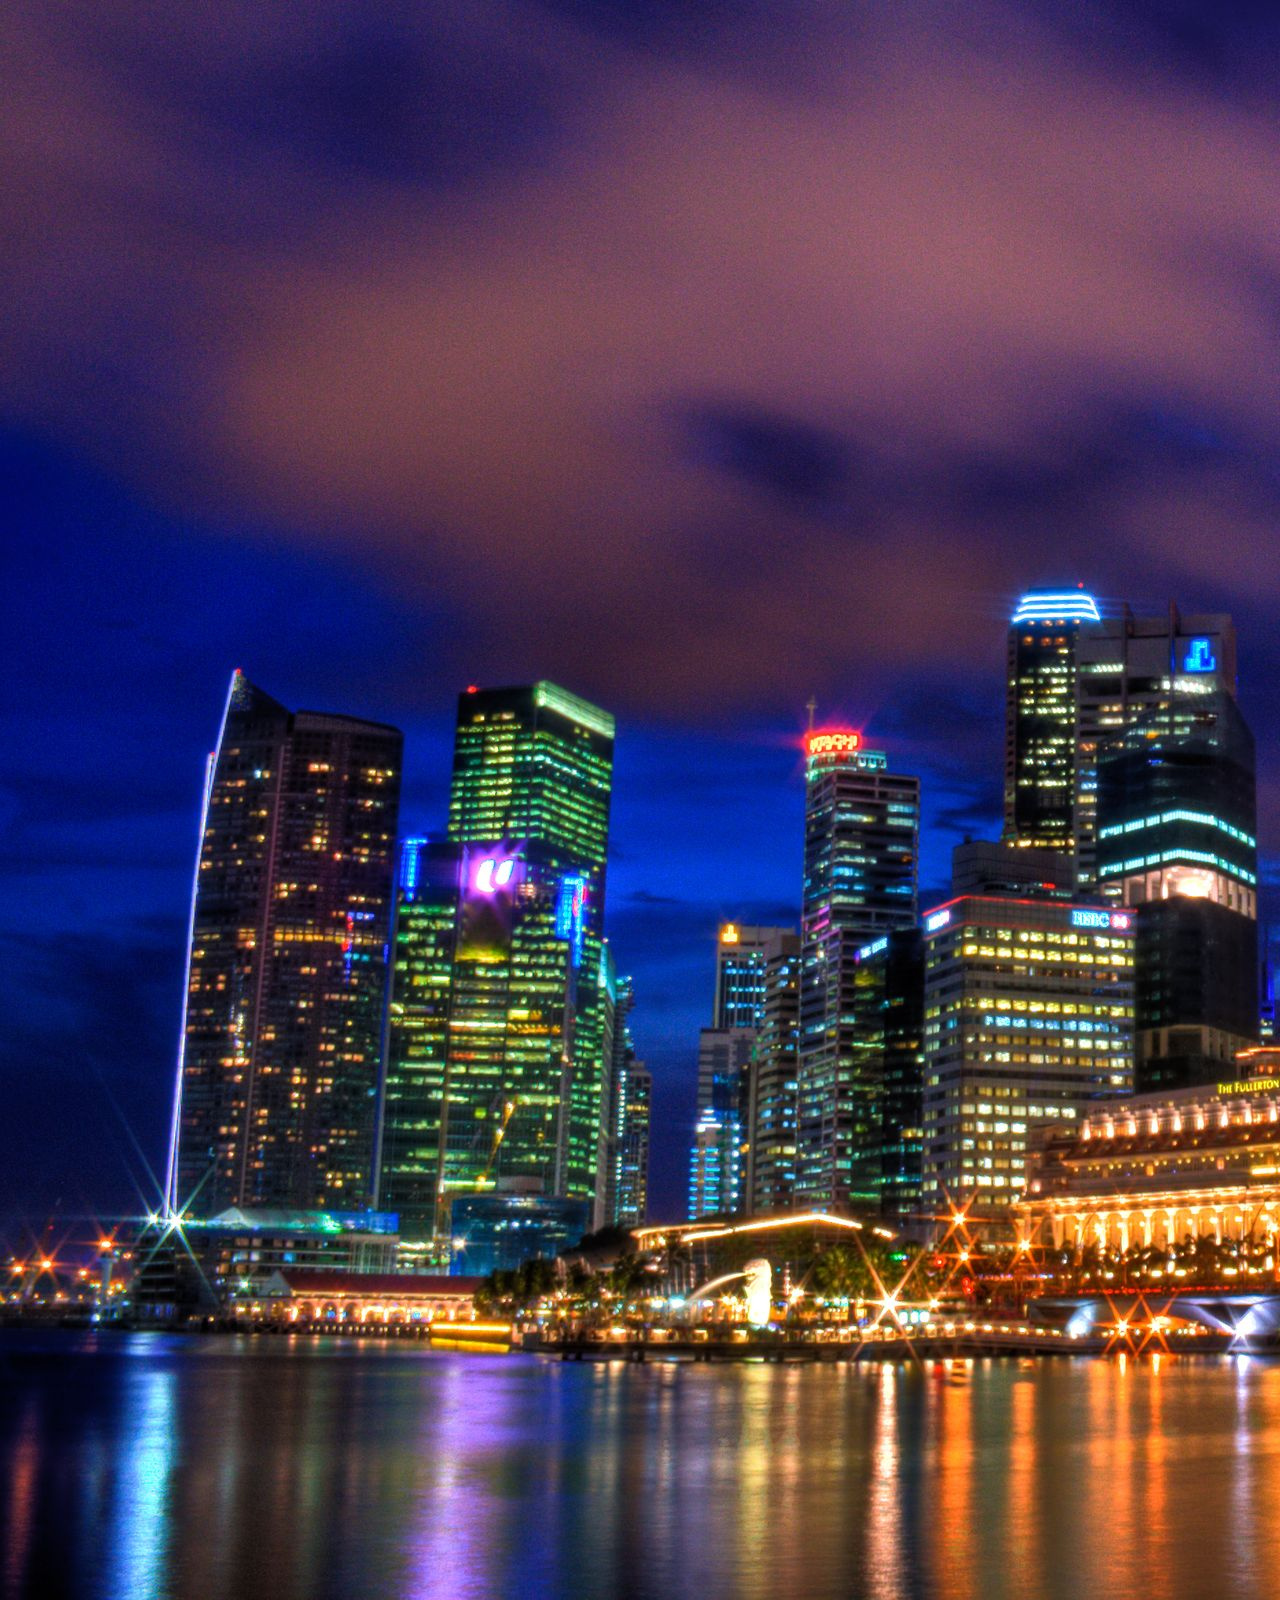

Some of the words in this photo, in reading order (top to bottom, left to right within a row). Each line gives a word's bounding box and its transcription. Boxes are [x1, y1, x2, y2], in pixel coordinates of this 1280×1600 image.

[1072, 910, 1110, 928] HSBC
[1218, 1083, 1233, 1094] THE
[1235, 1080, 1280, 1093] FULLERTON
